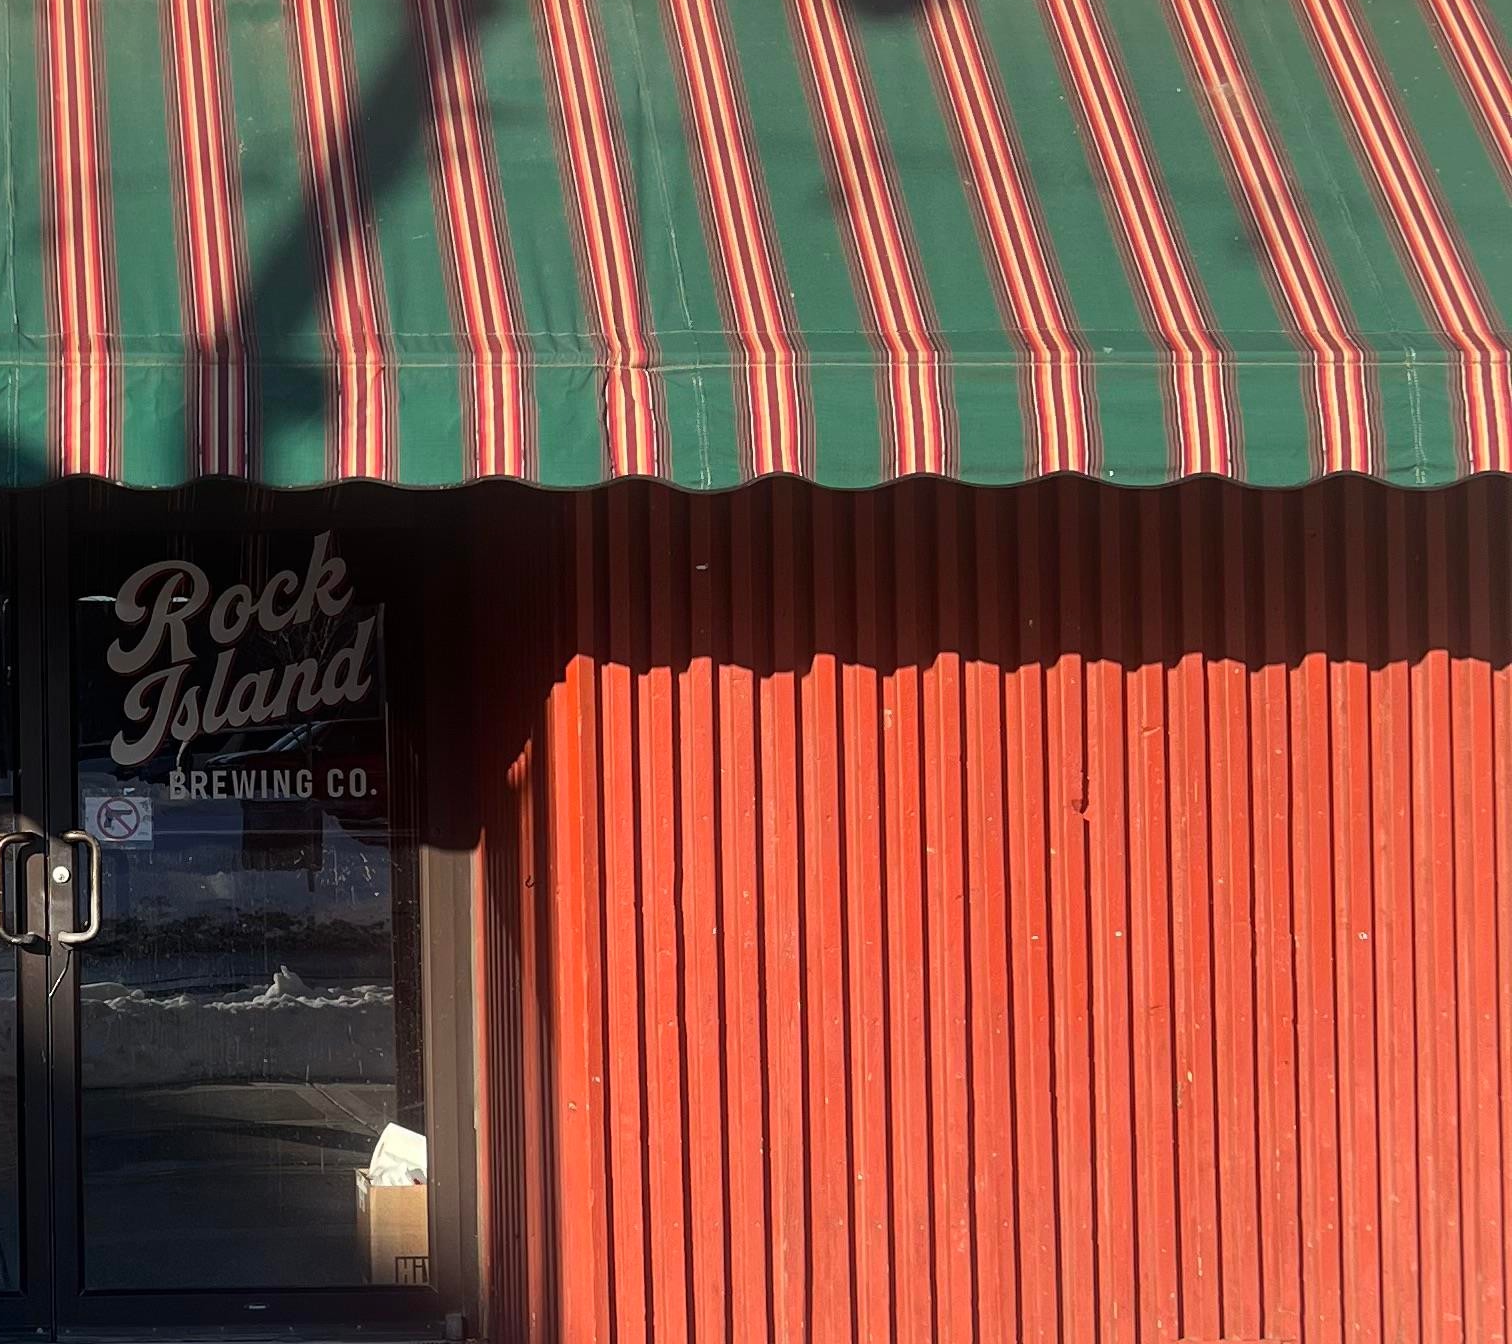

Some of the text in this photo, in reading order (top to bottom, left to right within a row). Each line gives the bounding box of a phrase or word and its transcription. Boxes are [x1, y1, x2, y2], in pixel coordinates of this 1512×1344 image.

[106, 530, 354, 674] Rock
[110, 616, 376, 766] Island
[169, 767, 378, 800] BREWING CO.
